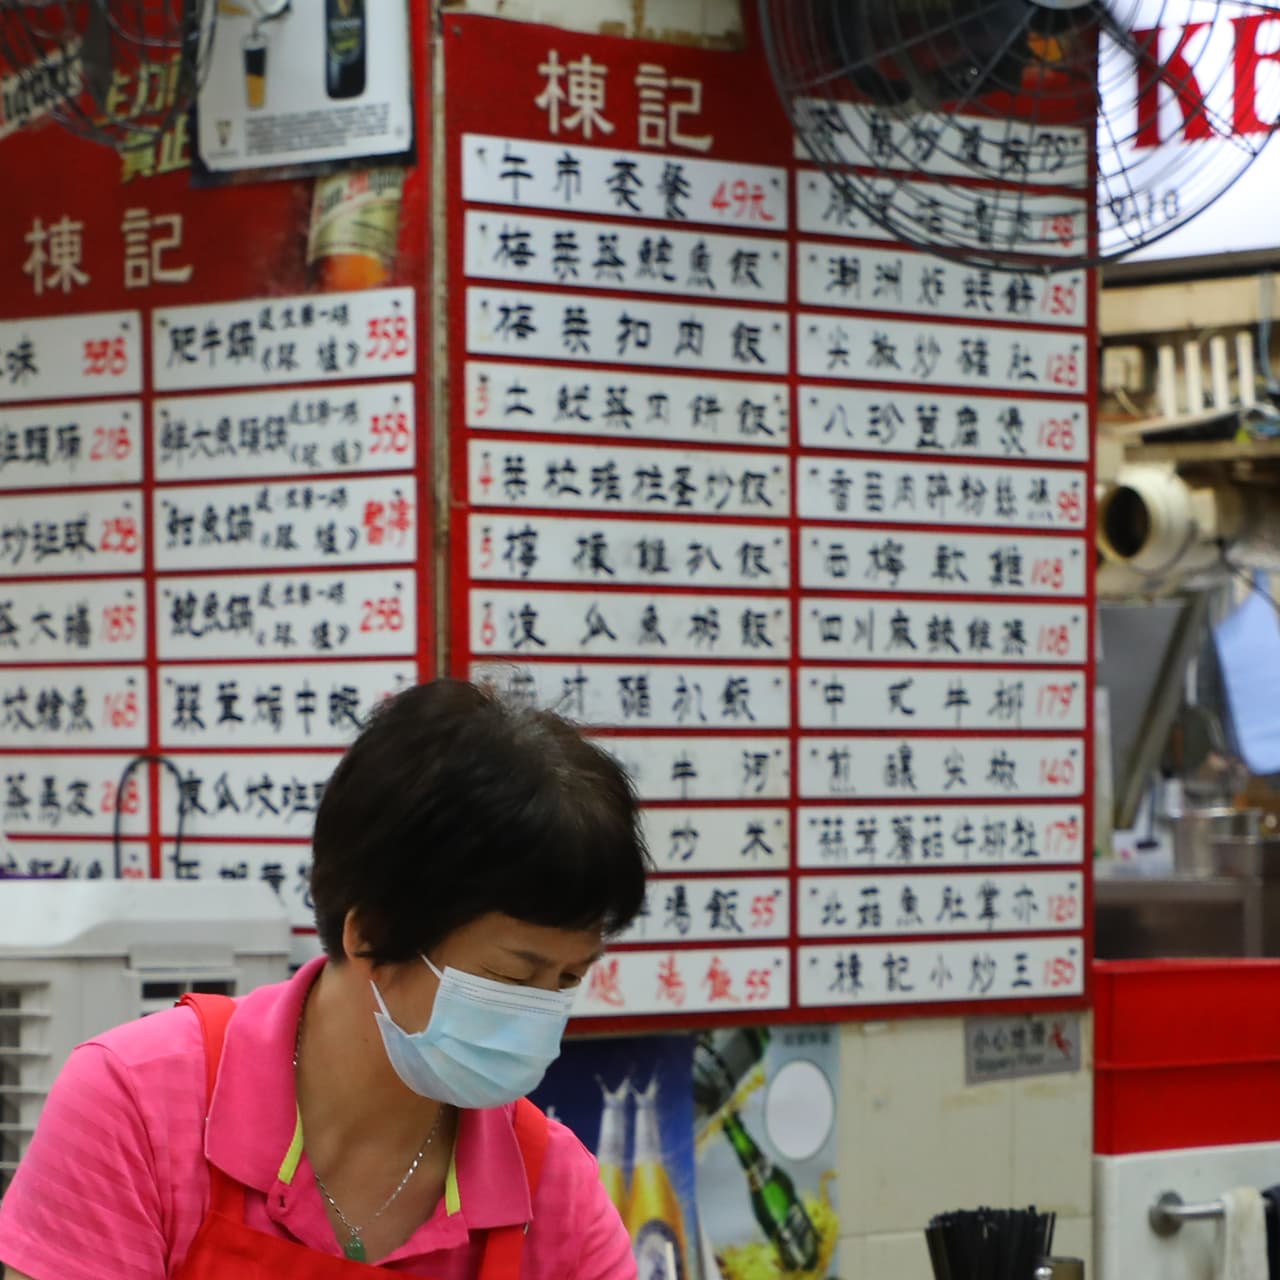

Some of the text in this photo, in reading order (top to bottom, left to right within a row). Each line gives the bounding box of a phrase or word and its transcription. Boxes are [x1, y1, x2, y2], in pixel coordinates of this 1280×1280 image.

[535, 48, 714, 153] 棟記
[499, 141, 691, 220] 午市套餐
[23, 208, 193, 295] 棟記
